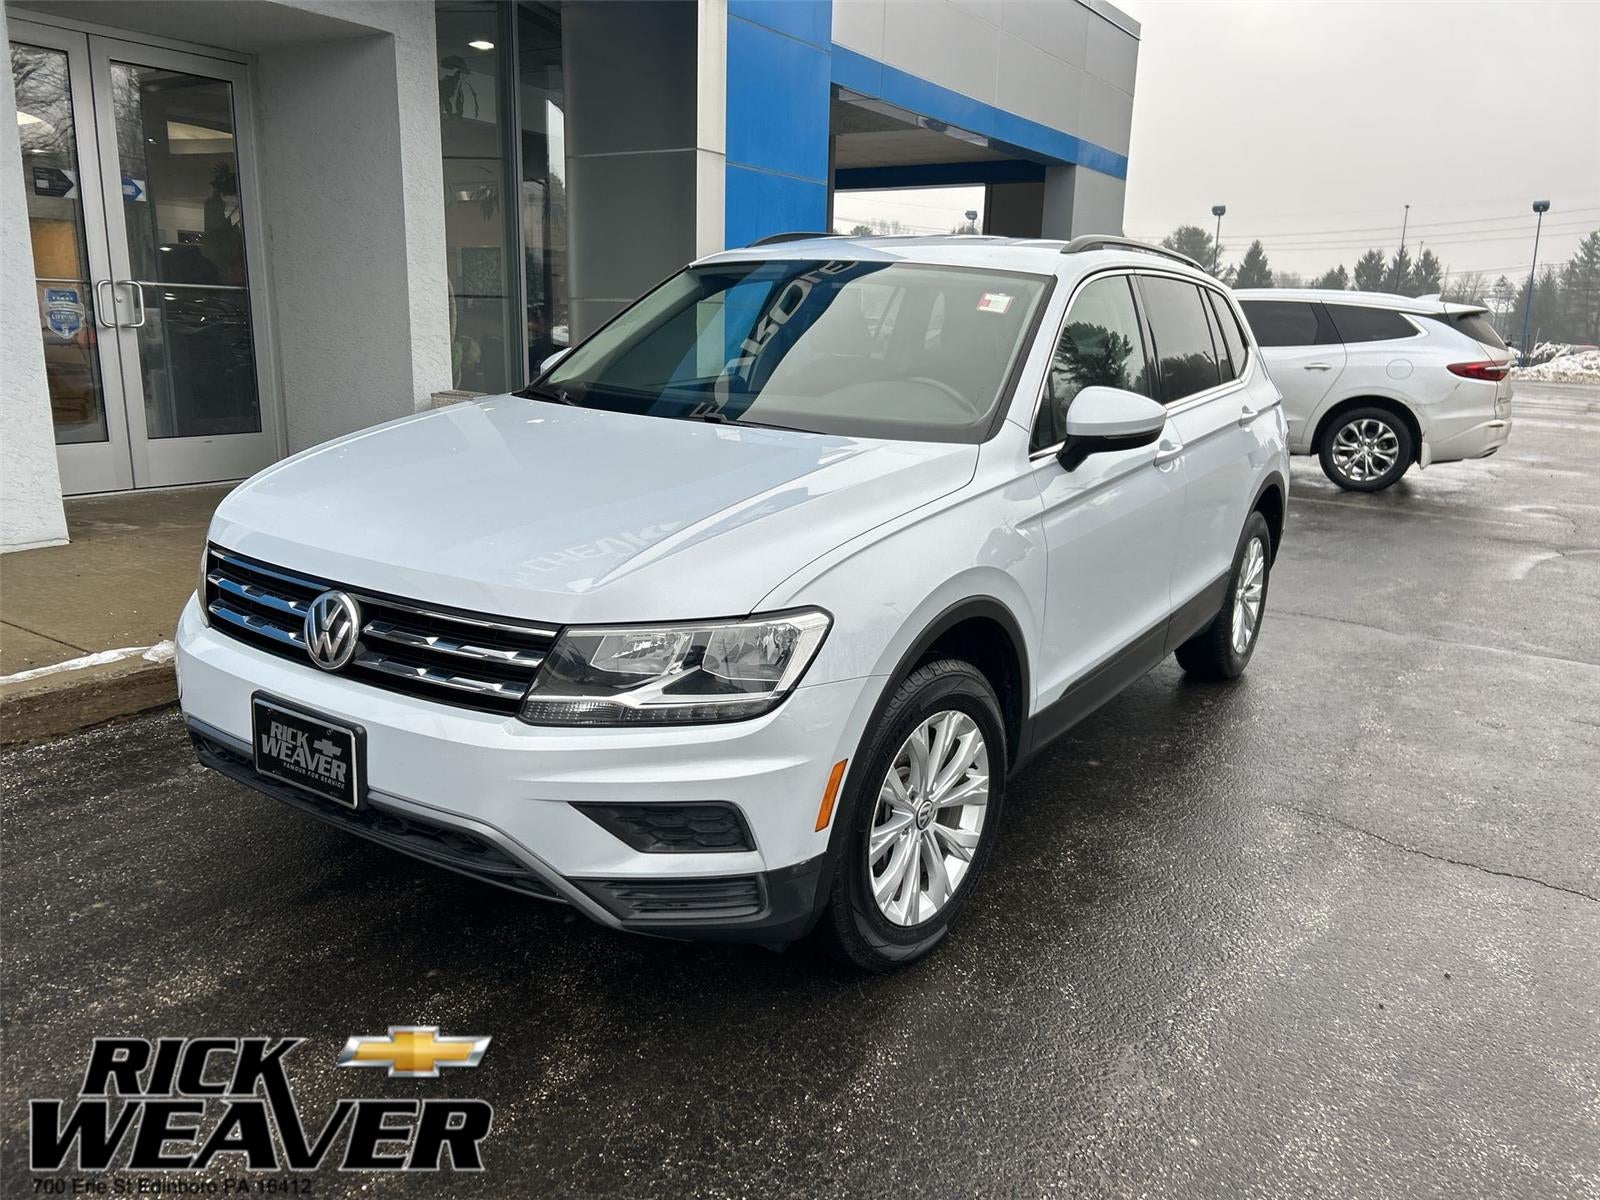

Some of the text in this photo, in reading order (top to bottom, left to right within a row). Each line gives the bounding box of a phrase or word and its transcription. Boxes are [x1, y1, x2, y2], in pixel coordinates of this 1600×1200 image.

[270, 720, 309, 747] RICK
[261, 733, 347, 783] WEAVER
[307, 770, 320, 779] FOR
